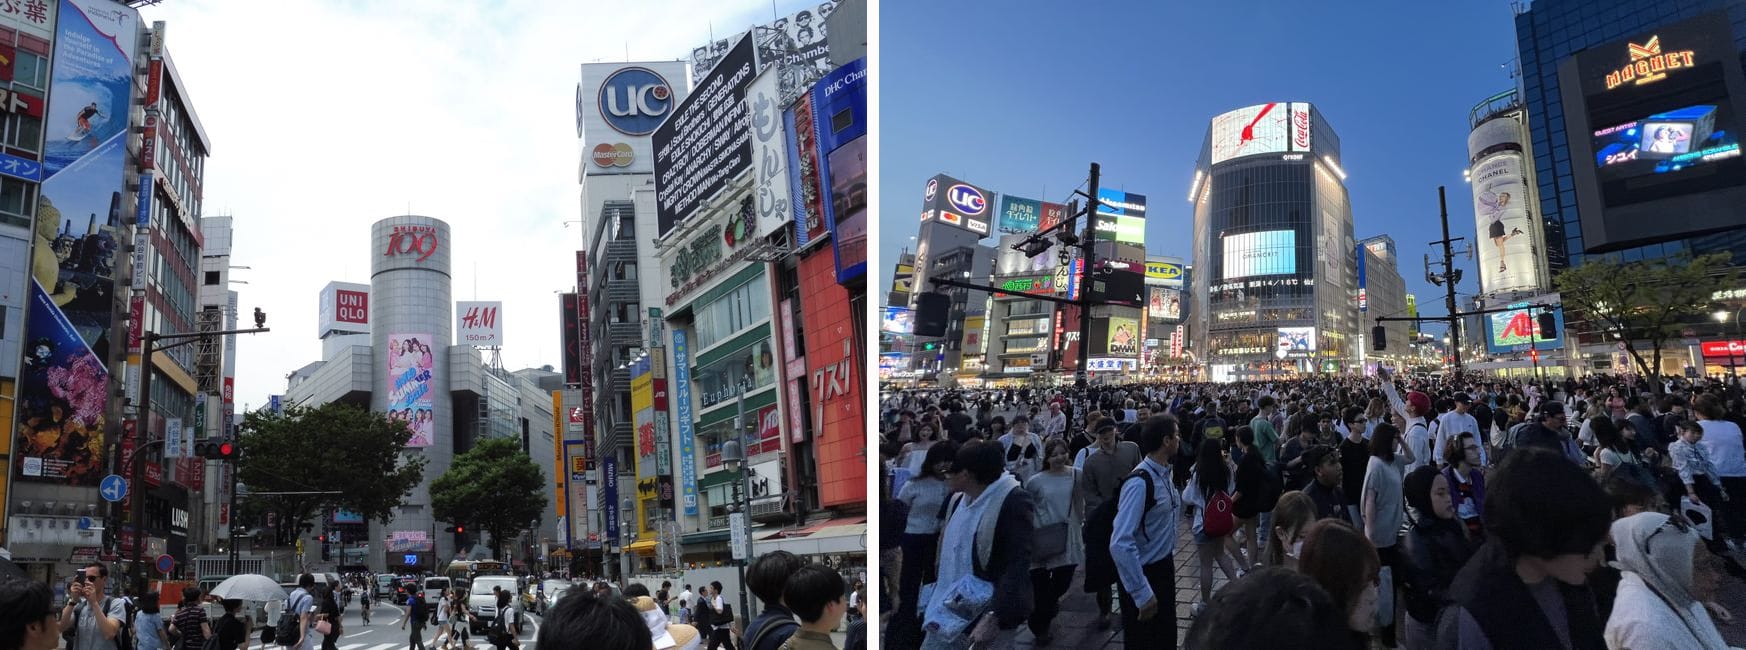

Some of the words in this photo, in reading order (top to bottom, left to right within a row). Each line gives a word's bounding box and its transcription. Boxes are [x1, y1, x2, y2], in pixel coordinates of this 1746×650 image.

[65, 29, 91, 42] Indulge
[1606, 51, 1694, 90] MAGNET
[672, 128, 683, 148] Soul
[683, 106, 704, 137] Brothers
[707, 59, 750, 112] GENERATIONS
[674, 107, 689, 132] EXILE
[689, 96, 699, 117] THE
[700, 70, 723, 106] SECOND
[825, 80, 843, 97] DHC
[671, 141, 685, 163] EXILE
[685, 116, 710, 150] SHOKICHI
[1294, 111, 1308, 147] Coca-Cola
[1595, 128, 1615, 136] GUEST
[1615, 122, 1637, 131] ARTIST
[594, 150, 633, 159] MasterCard
[662, 151, 688, 185] CRAZYBOY
[691, 117, 723, 157] DOBERMAN
[685, 146, 711, 178] ANARCHY
[714, 127, 730, 151] SWAY
[752, 91, 788, 222] もんじゃ
[663, 186, 681, 211] MIGHTY
[682, 167, 703, 194] CROWN
[1479, 168, 1509, 182] CHANEL
[674, 188, 696, 213] METHOD
[697, 174, 710, 196] MAN
[393, 226, 437, 234] SHIBUYA
[384, 231, 438, 262] 109
[1148, 265, 1178, 275] KEA
[463, 306, 496, 330] H&M
[1219, 346, 1267, 355] STARBUCKS
[675, 352, 696, 445] サマーフルーツギフト
[703, 376, 752, 406] Euphoria
[762, 408, 779, 434] JTB
[172, 507, 189, 529] LUSH
